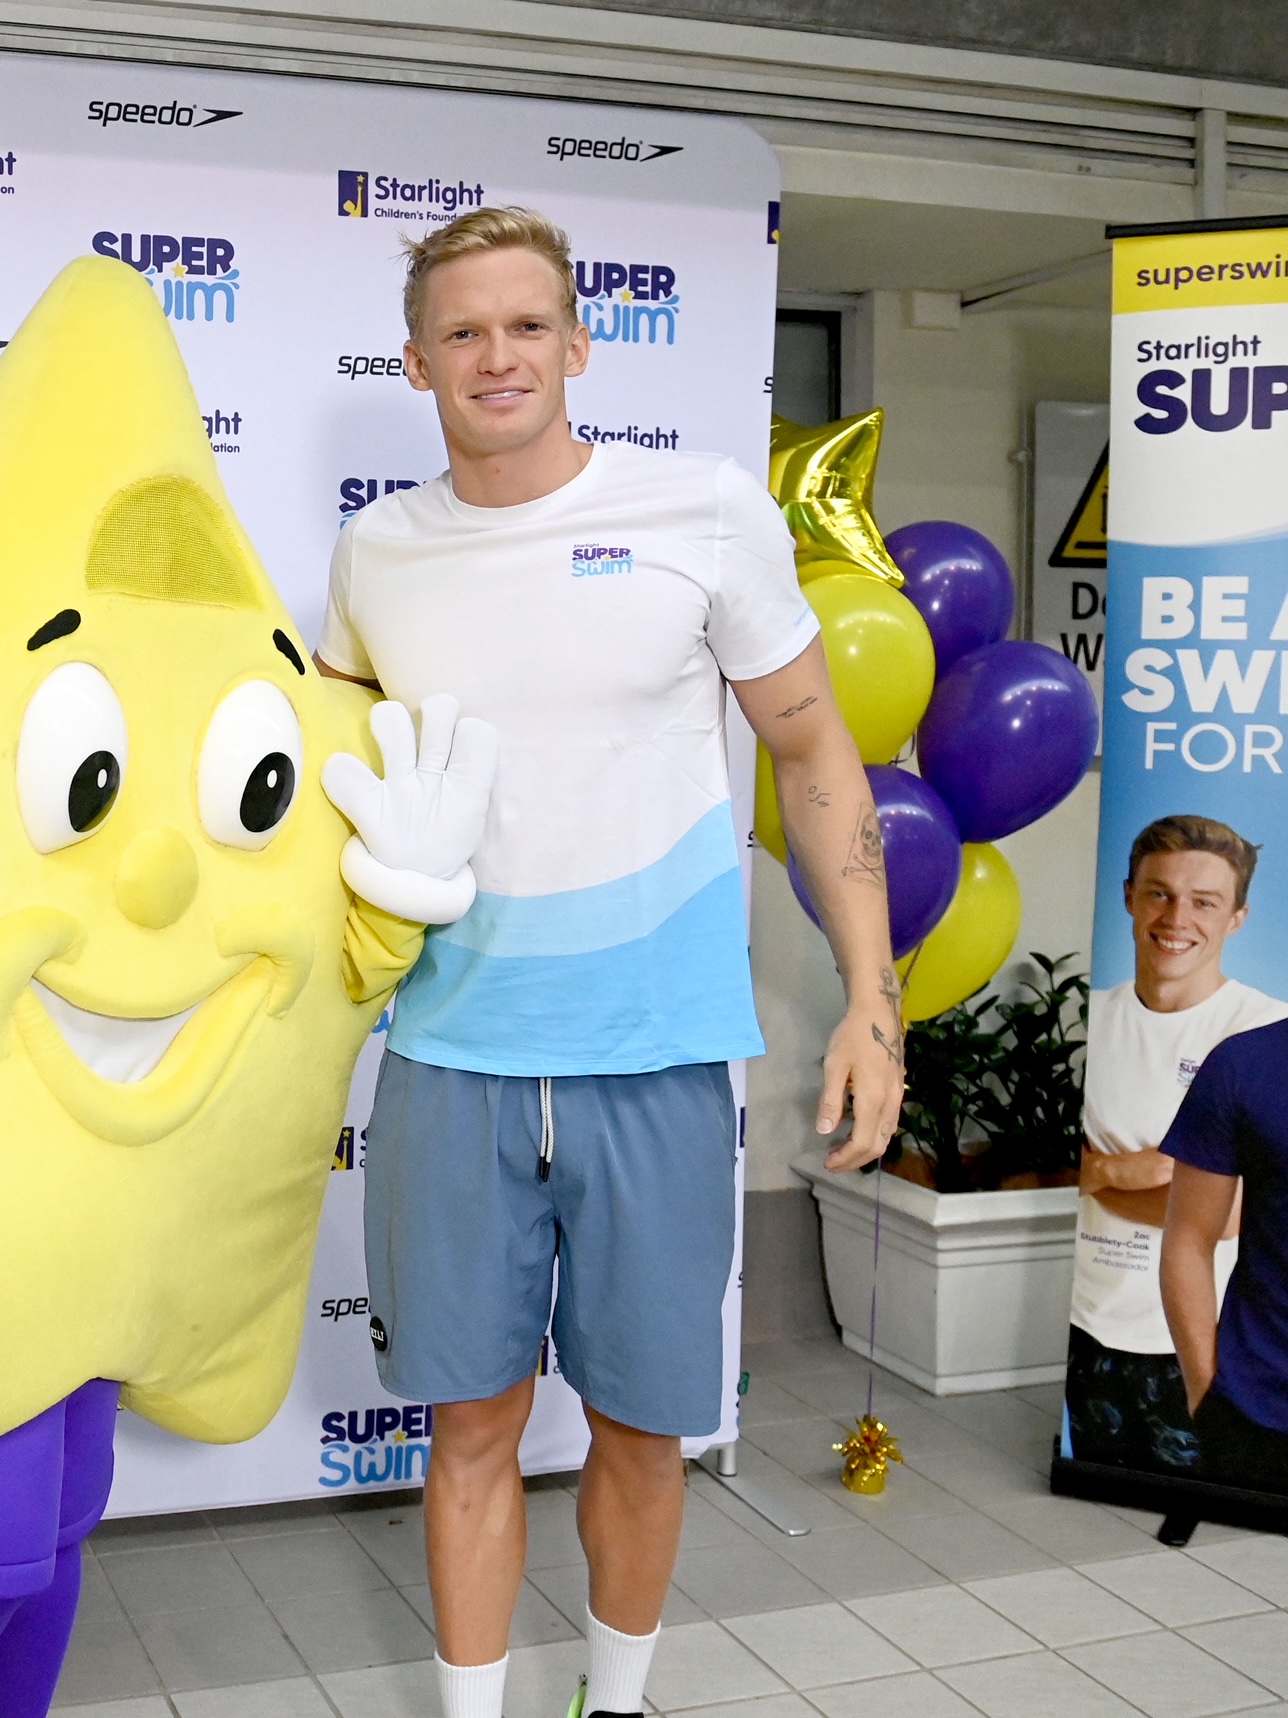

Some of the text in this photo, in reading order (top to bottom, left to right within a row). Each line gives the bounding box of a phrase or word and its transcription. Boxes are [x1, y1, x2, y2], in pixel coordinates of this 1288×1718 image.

[88, 100, 194, 127] speedo
[547, 136, 640, 161] speedo
[375, 175, 485, 211] Starlight
[374, 207, 458, 222] Children's Found
[92, 231, 235, 276] SUPER
[1136, 253, 1288, 290] superswi
[575, 260, 676, 301] UPER
[1136, 333, 1262, 365] Starlight
[337, 355, 408, 380] spee
[1133, 364, 1288, 435] SUP
[572, 547, 632, 561] SUPER
[1140, 576, 1250, 640] BE
[1144, 721, 1284, 774] FOR
[321, 1297, 371, 1322] spe
[320, 1404, 433, 1445] SUPE
